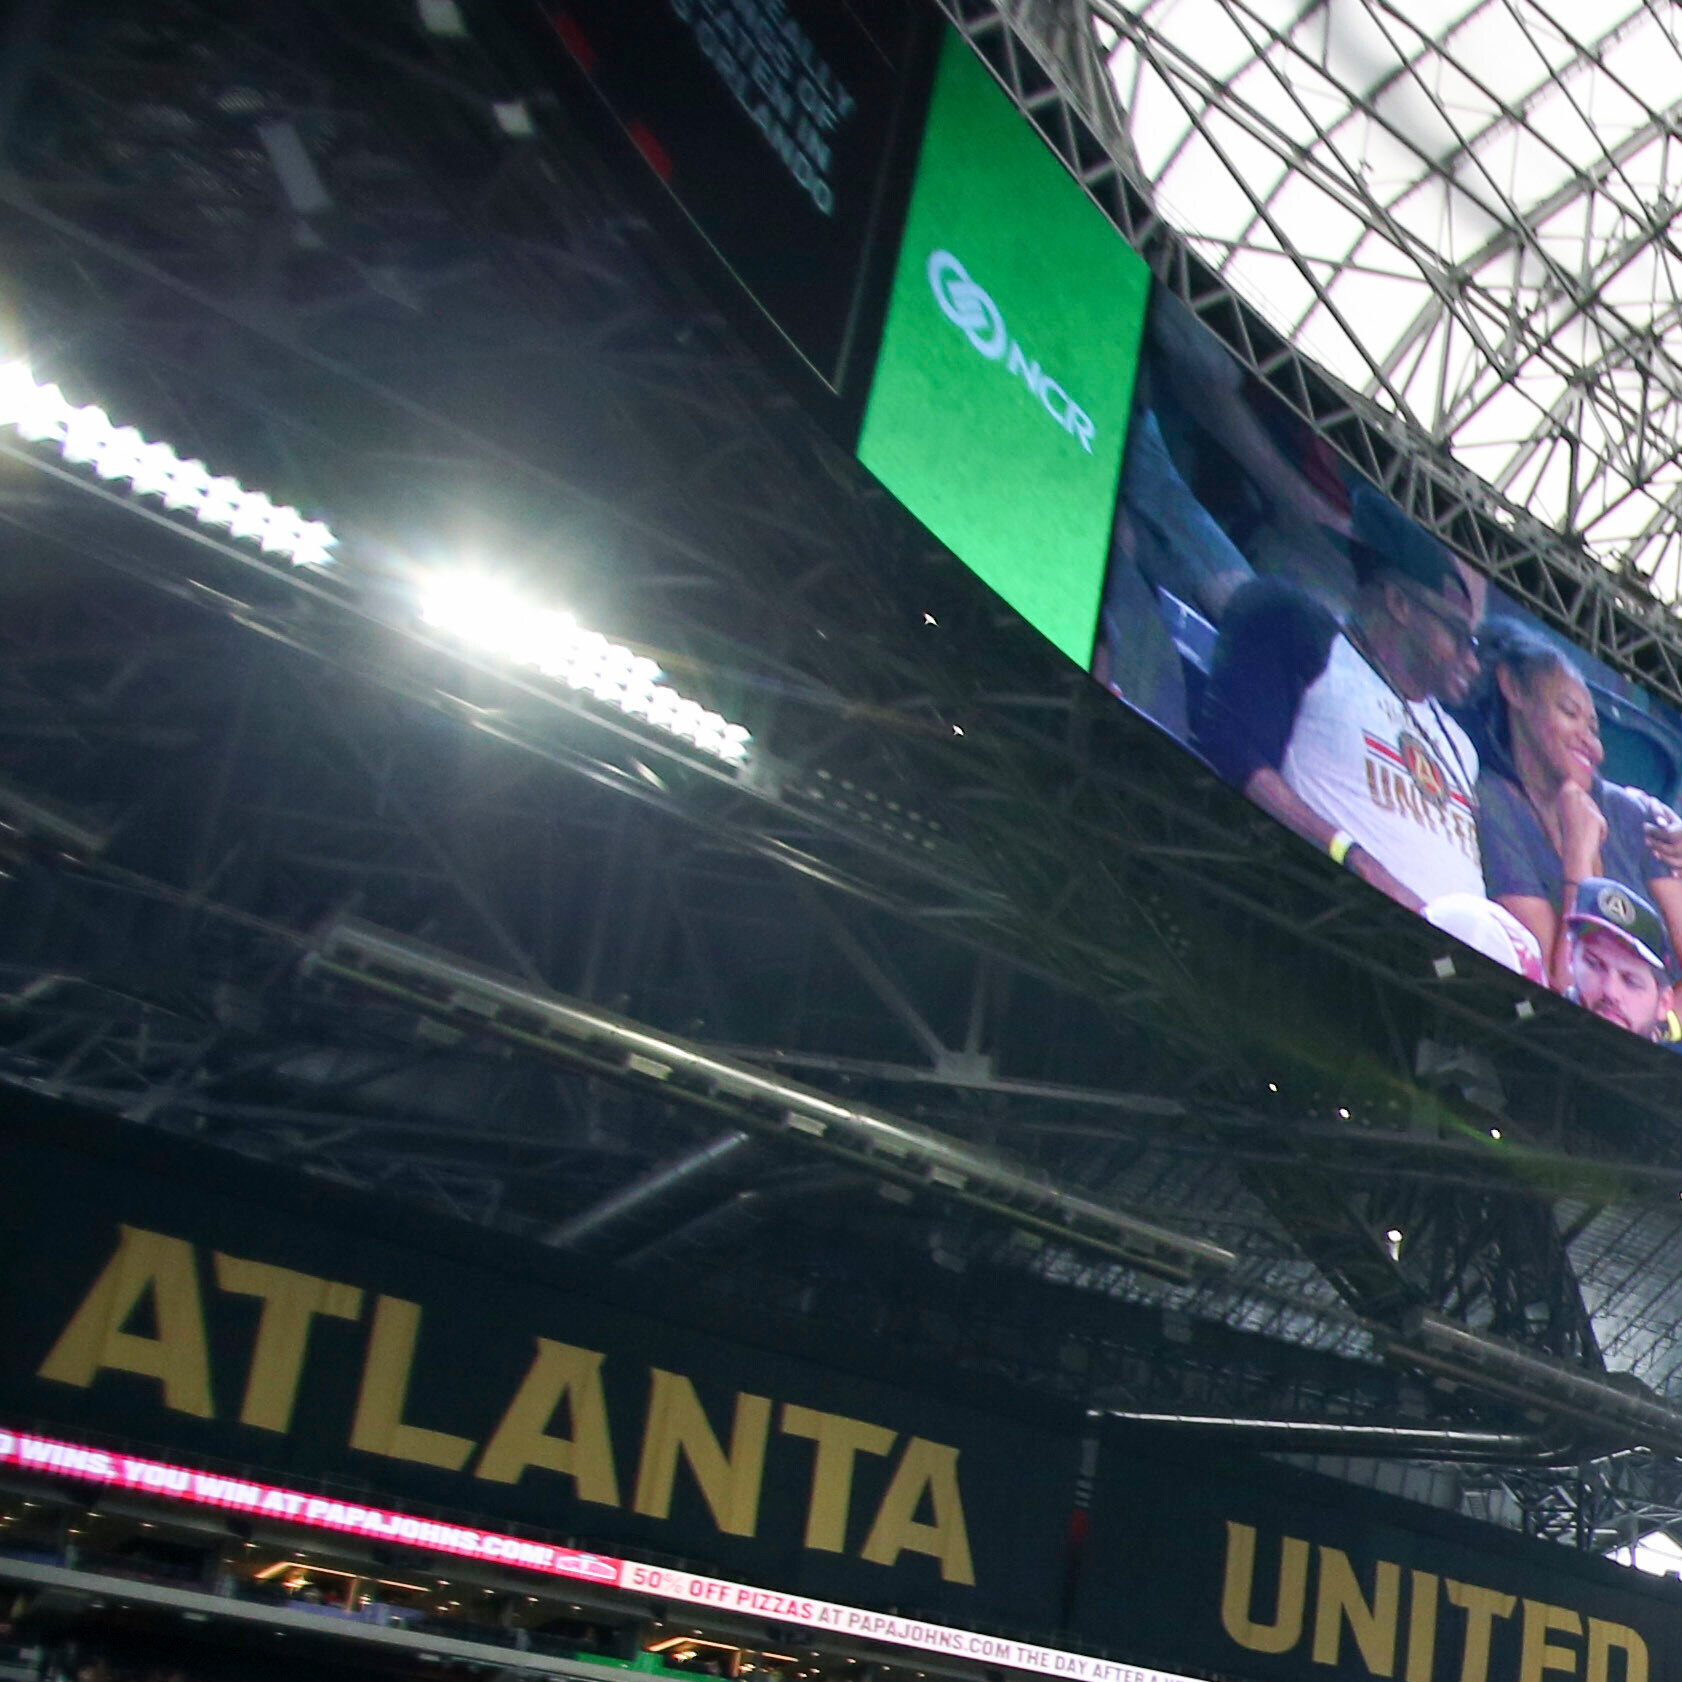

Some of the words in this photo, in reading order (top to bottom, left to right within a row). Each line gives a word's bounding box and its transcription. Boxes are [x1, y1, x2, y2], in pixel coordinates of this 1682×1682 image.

[1006, 349, 1096, 455] NCR
[37, 1223, 975, 1587] ATLANTA
[19, 1437, 117, 1477] WINS,
[121, 1458, 192, 1492] YOU
[195, 1472, 262, 1507] WIN
[261, 1490, 306, 1517] AT
[305, 1497, 555, 1567] PAPAJOHNS.COM!
[633, 1567, 684, 1594] 50%
[689, 1579, 730, 1602] OFF
[737, 1589, 812, 1620] PIZZAS
[818, 1605, 844, 1625] AT
[848, 1611, 1011, 1661] PAPAJOHNS.COM
[1016, 1647, 1049, 1667] THE
[1054, 1655, 1088, 1676] DAY
